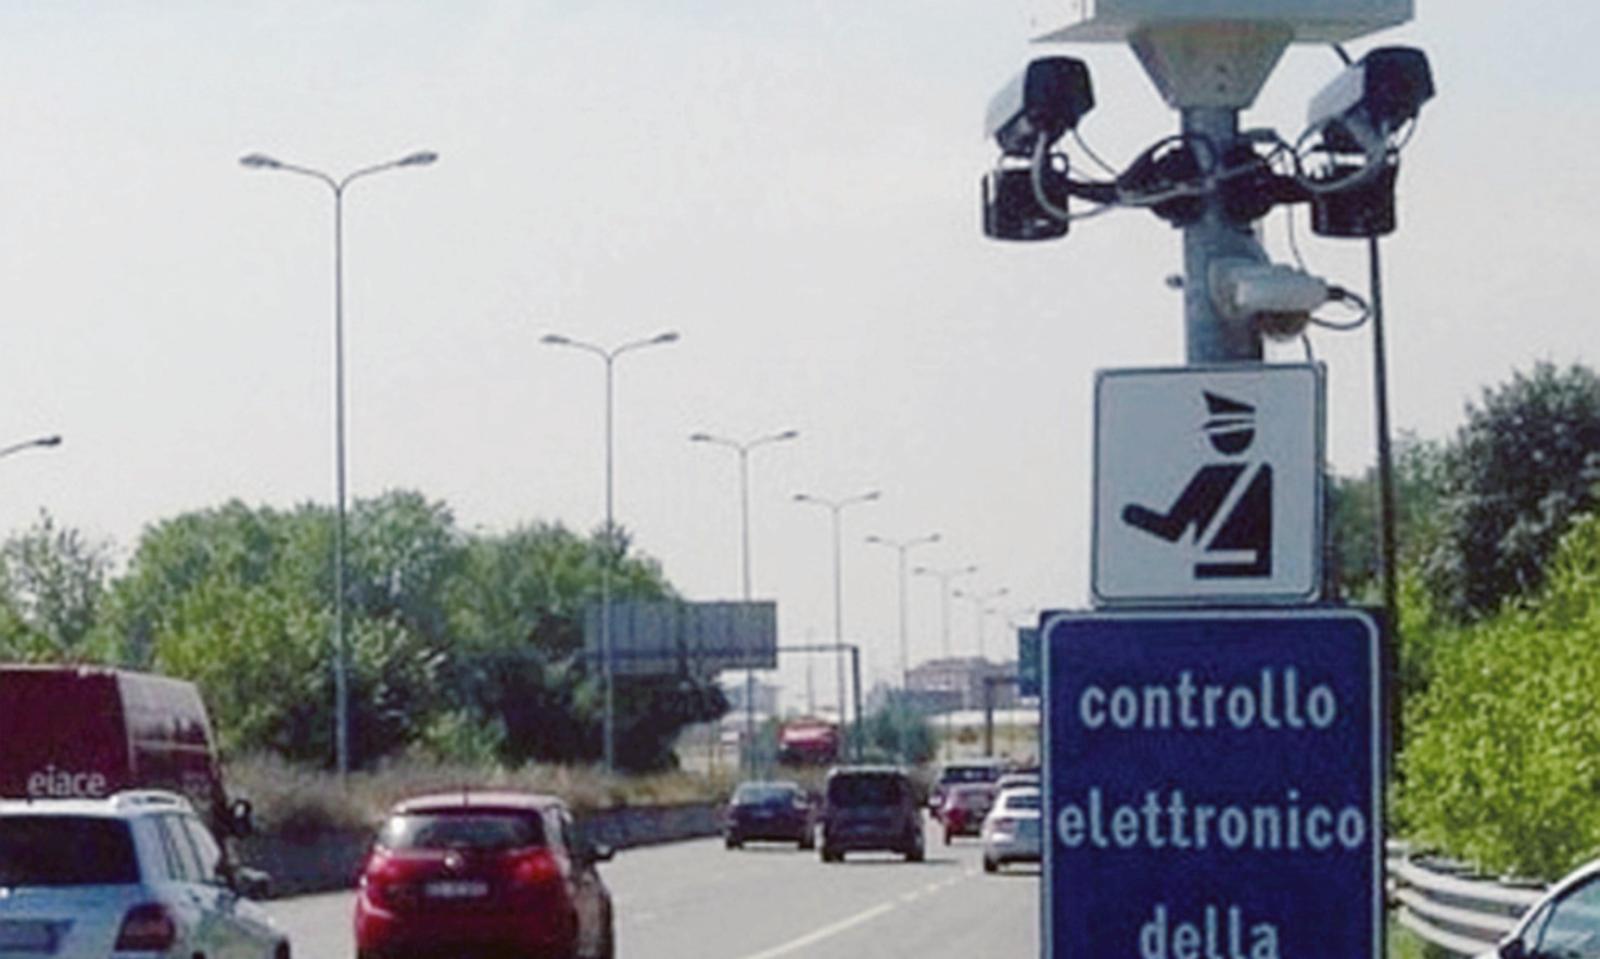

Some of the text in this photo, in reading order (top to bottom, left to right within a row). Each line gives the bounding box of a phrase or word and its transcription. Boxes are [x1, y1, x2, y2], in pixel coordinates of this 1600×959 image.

[1080, 667, 1336, 729] controllo
[1057, 788, 1366, 849] elettronico
[1140, 904, 1280, 959] della
